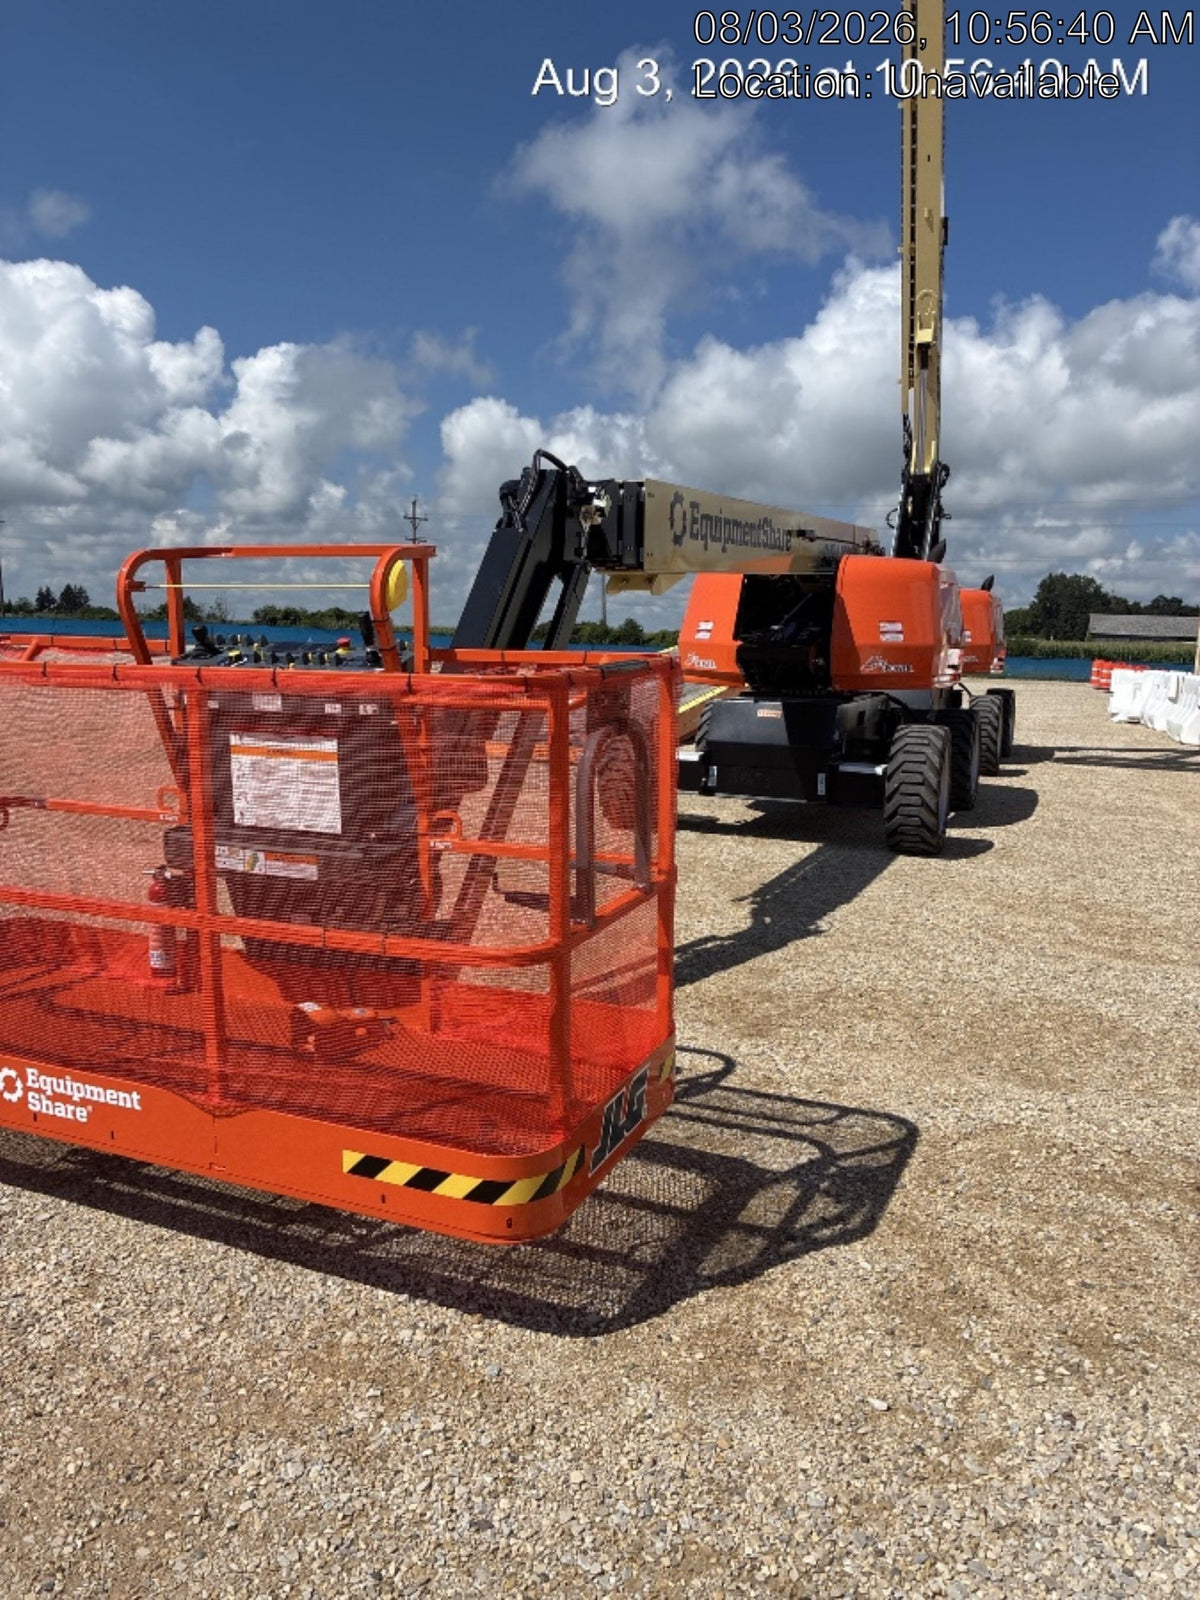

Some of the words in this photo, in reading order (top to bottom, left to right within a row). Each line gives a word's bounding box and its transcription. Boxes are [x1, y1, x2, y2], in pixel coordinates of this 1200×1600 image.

[689, 500, 792, 554] EquipmentShare
[25, 1066, 142, 1111] Equipment
[587, 1062, 650, 1179] JLG
